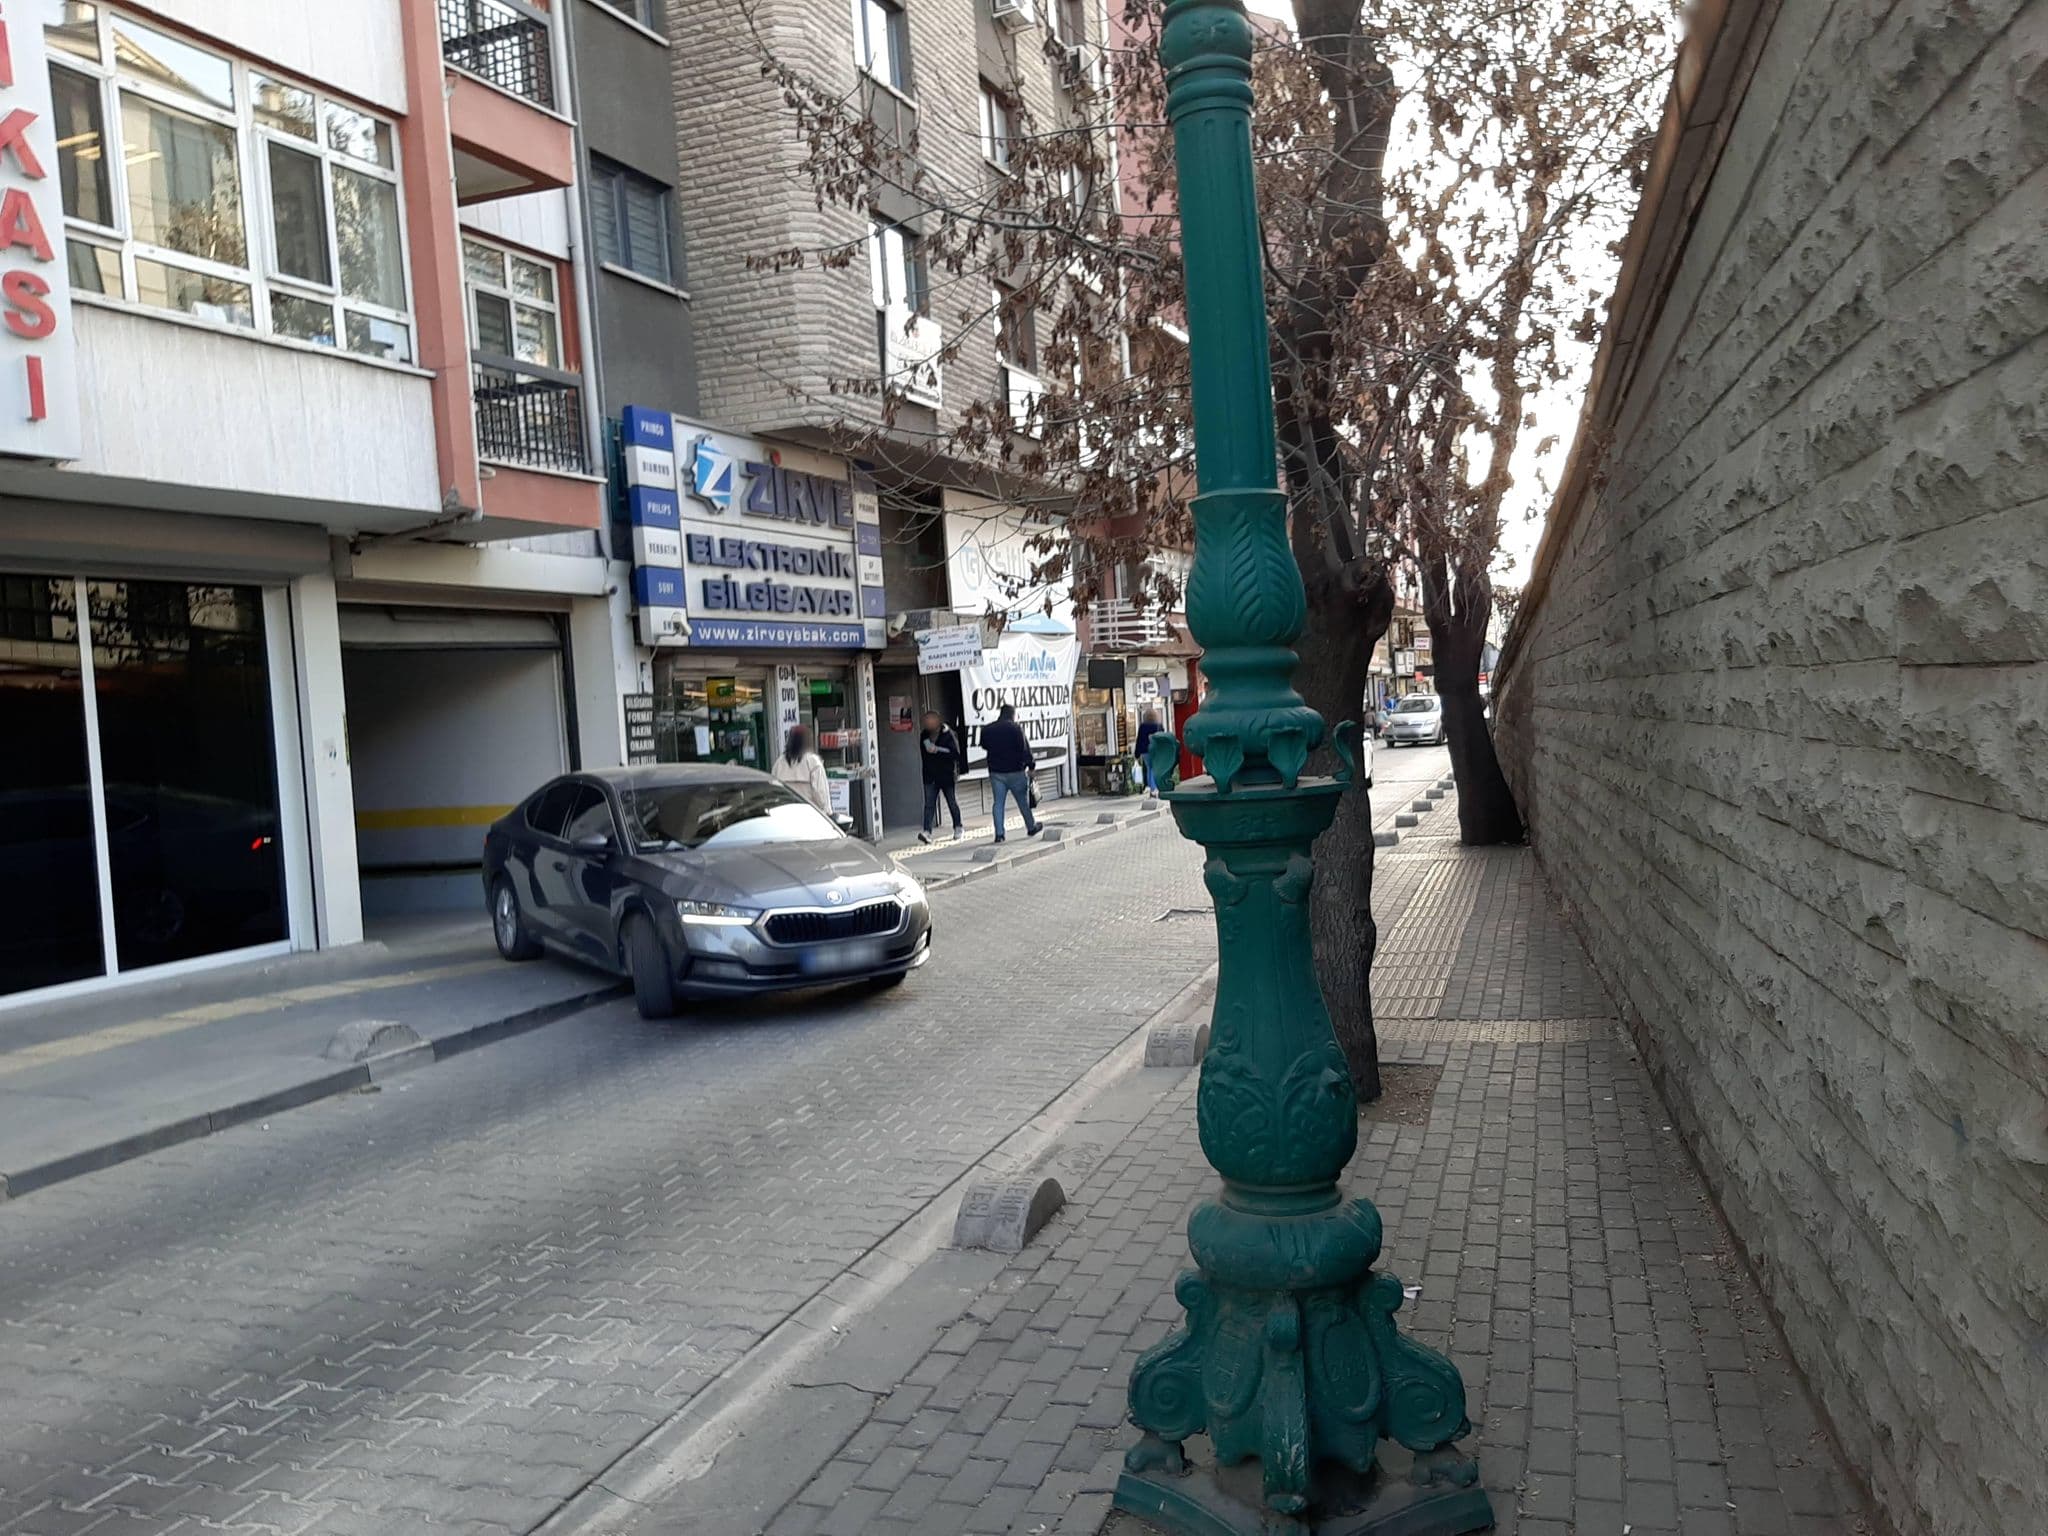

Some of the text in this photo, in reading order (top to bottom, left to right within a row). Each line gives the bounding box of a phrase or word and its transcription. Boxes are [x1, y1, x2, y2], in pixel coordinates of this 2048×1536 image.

[647, 501, 672, 516] PHILIPS
[687, 533, 852, 578] ELEKTRONİK
[658, 581, 674, 594] SONY
[703, 574, 853, 616] BİLGİSAYAR
[698, 623, 860, 645] www.zirveyebak.com
[781, 687, 796, 702] DVD
[971, 684, 1070, 719] ÇOK YAKINDA
[627, 711, 653, 724] FORMAT
[783, 708, 798, 723] JAK
[631, 725, 652, 737] BAKIM
[630, 739, 655, 752] ONARIM
